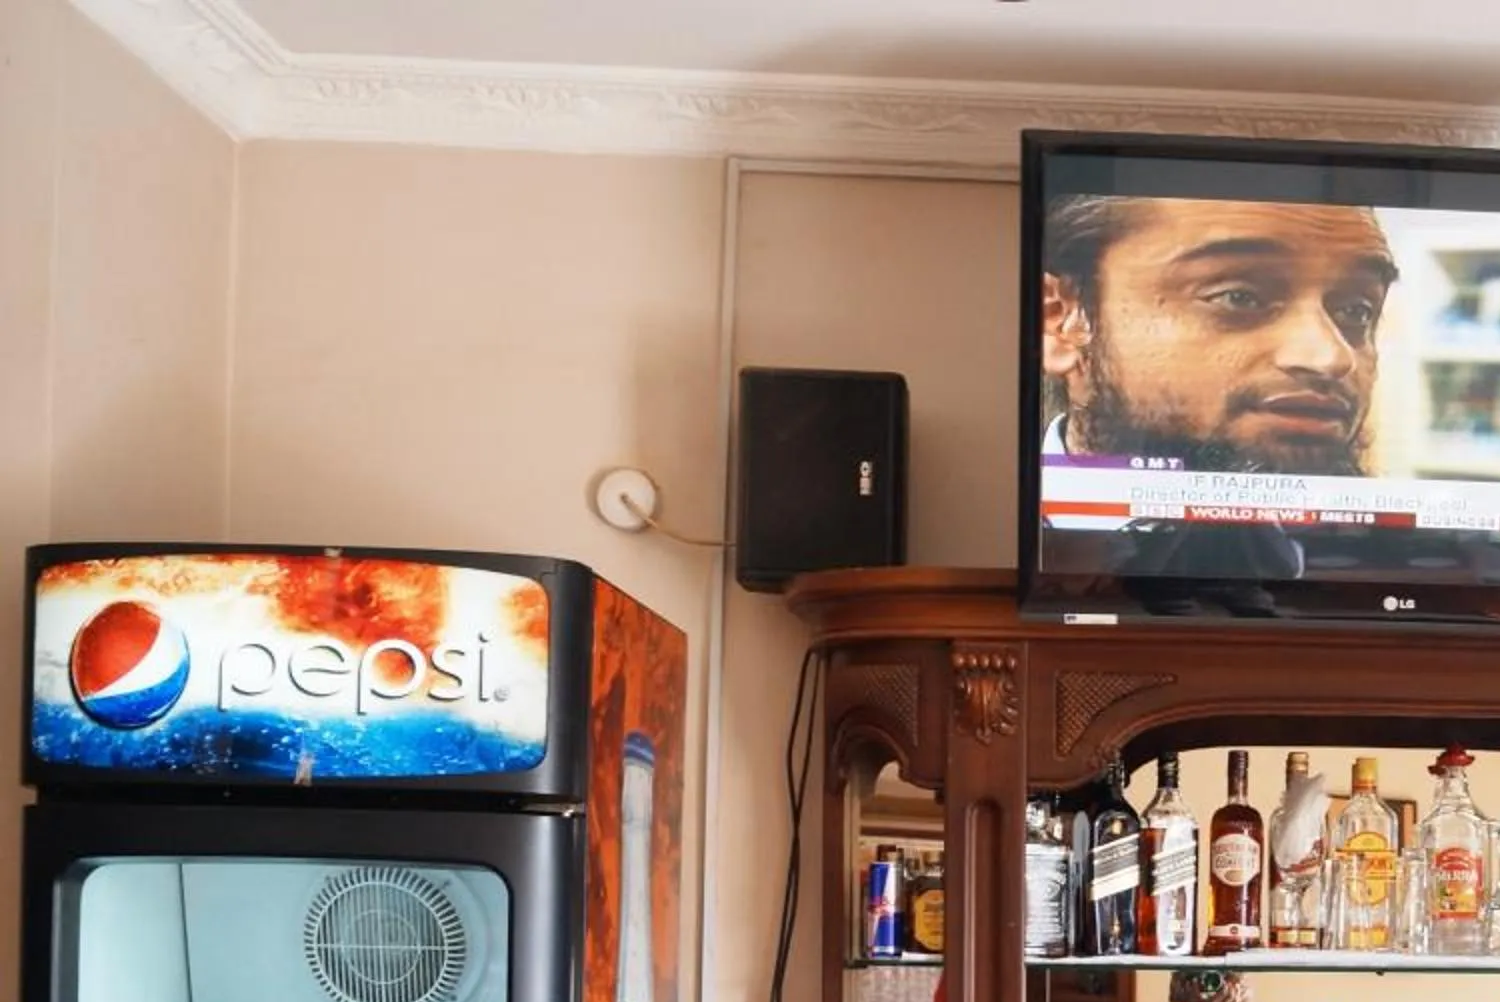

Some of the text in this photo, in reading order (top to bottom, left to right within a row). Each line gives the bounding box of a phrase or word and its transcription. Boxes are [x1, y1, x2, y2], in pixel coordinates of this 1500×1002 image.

[1130, 457, 1179, 469] GMT
[1213, 475, 1307, 491] RAJPURA
[1191, 507, 1307, 521] WORLD NEWS
[1400, 599, 1415, 609] LG
[215, 630, 494, 716] pepsi
